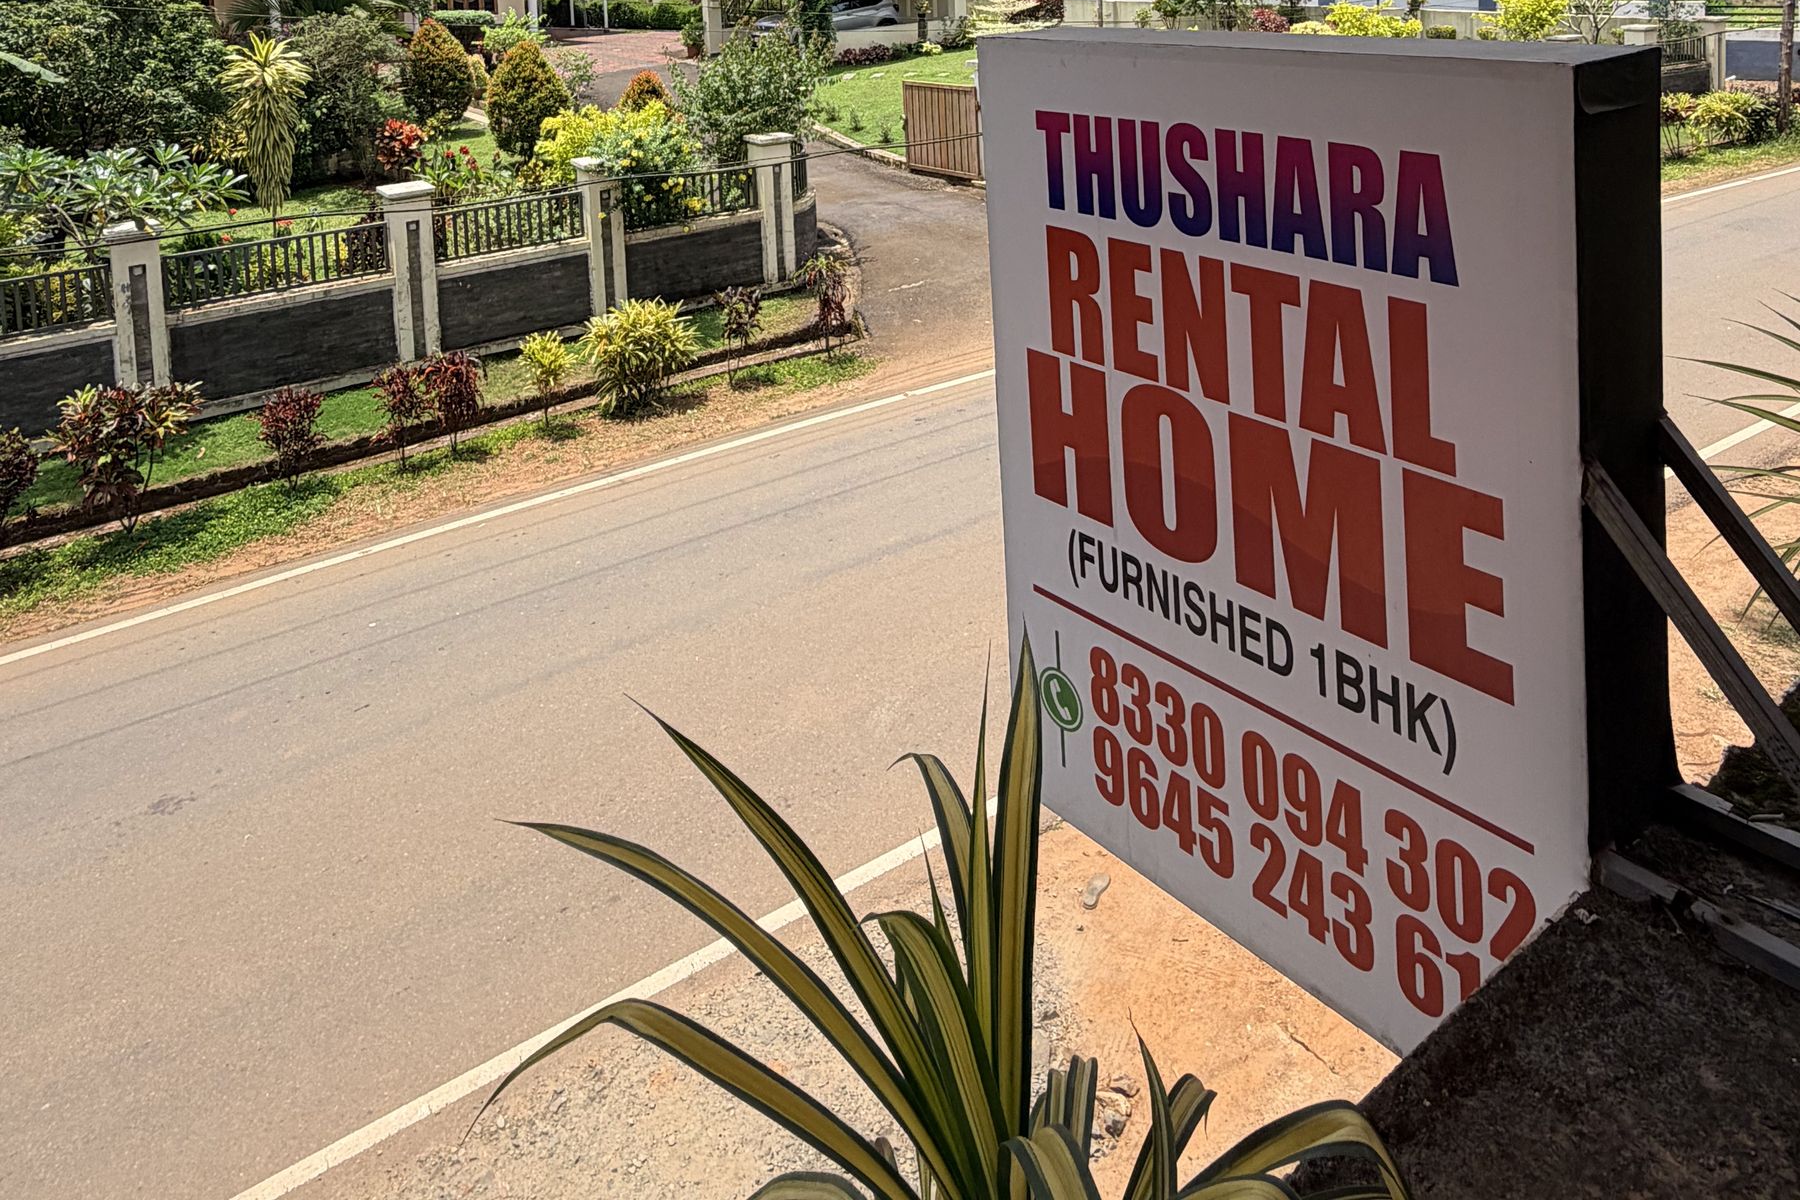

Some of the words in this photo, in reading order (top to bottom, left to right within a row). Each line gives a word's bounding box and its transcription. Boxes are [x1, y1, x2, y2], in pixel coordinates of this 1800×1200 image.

[1035, 110, 1460, 287] THUSHARA
[1045, 224, 1457, 477] RENTAL
[1026, 347, 1515, 706] HOME
[1068, 528, 1294, 677] (FURNISHED
[1310, 642, 1457, 776] 1BHK)
[1089, 646, 1227, 790] 8330
[1241, 730, 1369, 878] 094
[1384, 808, 1537, 963] 302
[1093, 725, 1235, 879] 9645
[1249, 821, 1375, 972] 243
